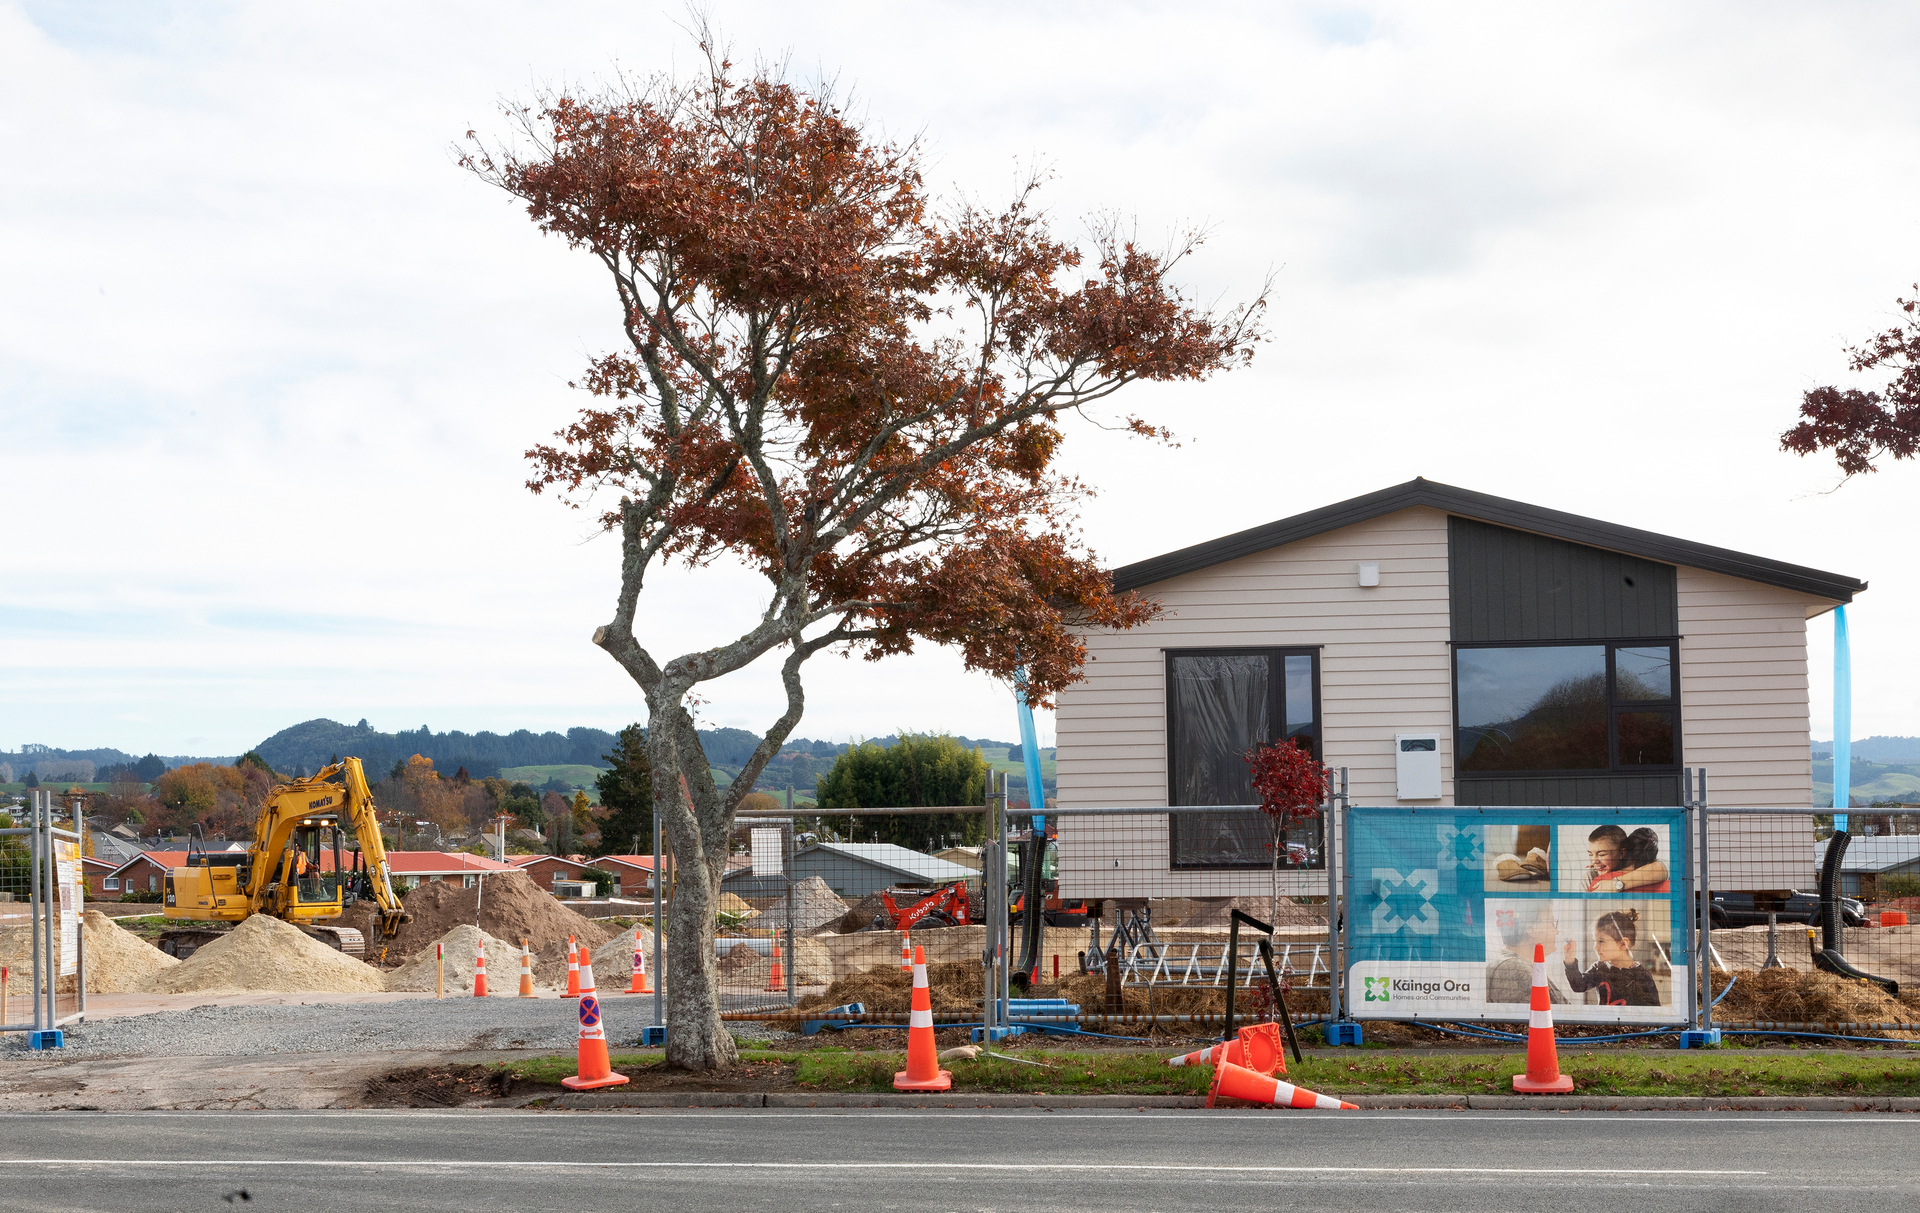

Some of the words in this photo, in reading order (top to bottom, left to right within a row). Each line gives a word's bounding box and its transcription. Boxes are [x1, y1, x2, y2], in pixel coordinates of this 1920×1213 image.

[308, 795, 333, 810] KOMATSU
[908, 901, 935, 920] Kubota
[1393, 979, 1440, 994] Kāinga
[1443, 979, 1470, 992] Ora
[1429, 994, 1470, 1002] Communities
